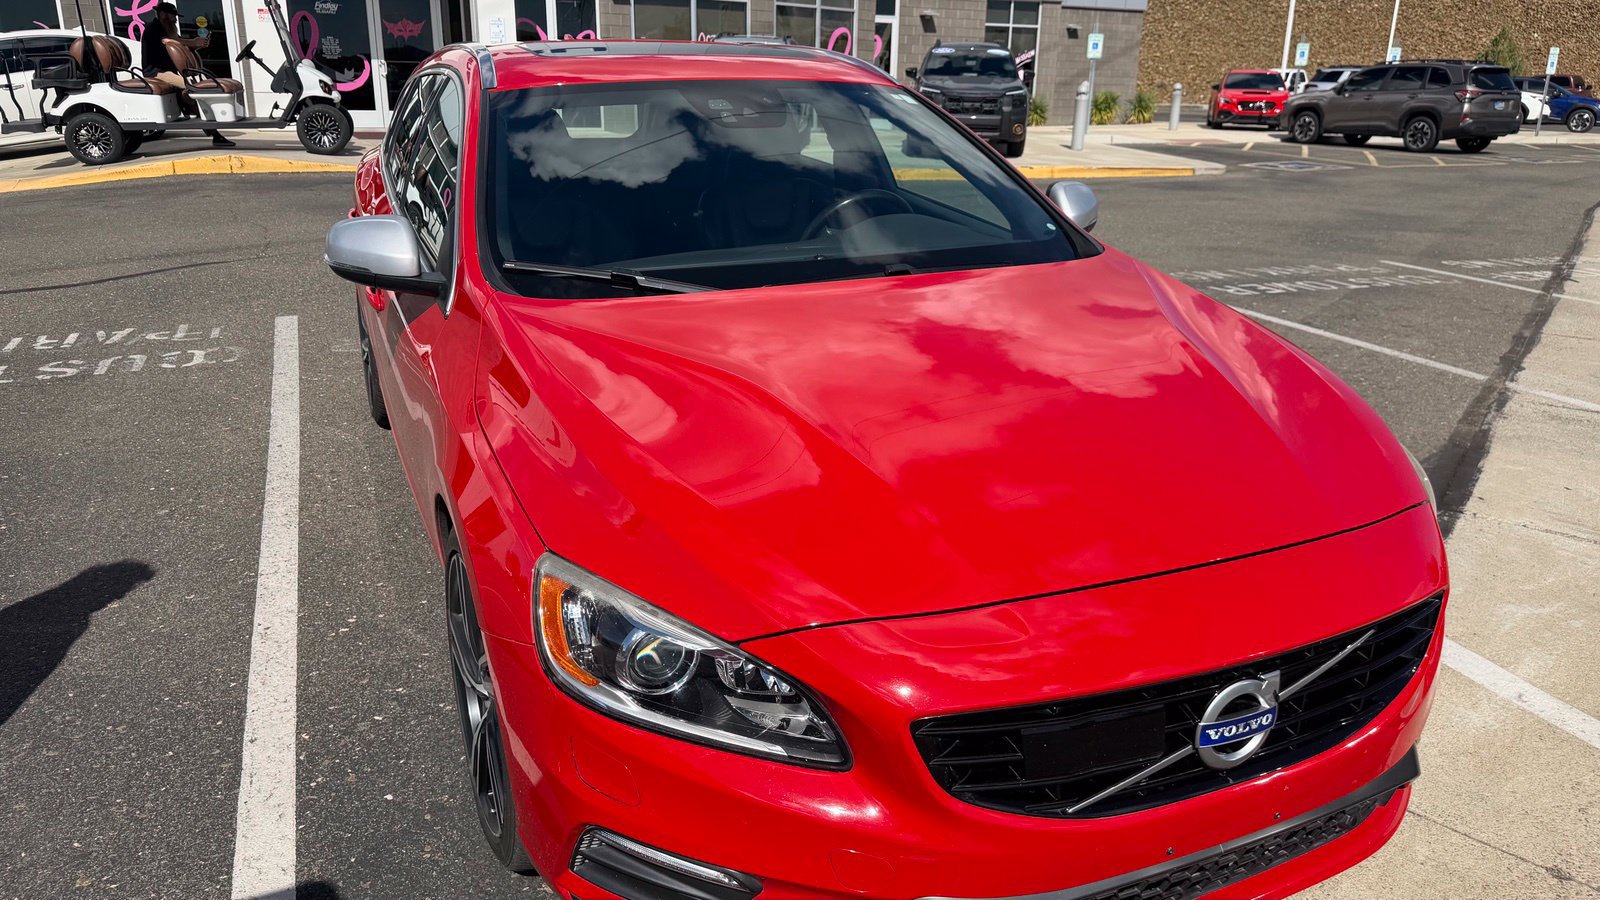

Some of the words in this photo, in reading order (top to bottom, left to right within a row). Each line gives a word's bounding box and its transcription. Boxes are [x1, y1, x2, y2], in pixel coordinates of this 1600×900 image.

[314, 2, 338, 10] Findlay
[1207, 275, 1445, 295] CUSTOMER
[1205, 713, 1273, 740] VOLVO
